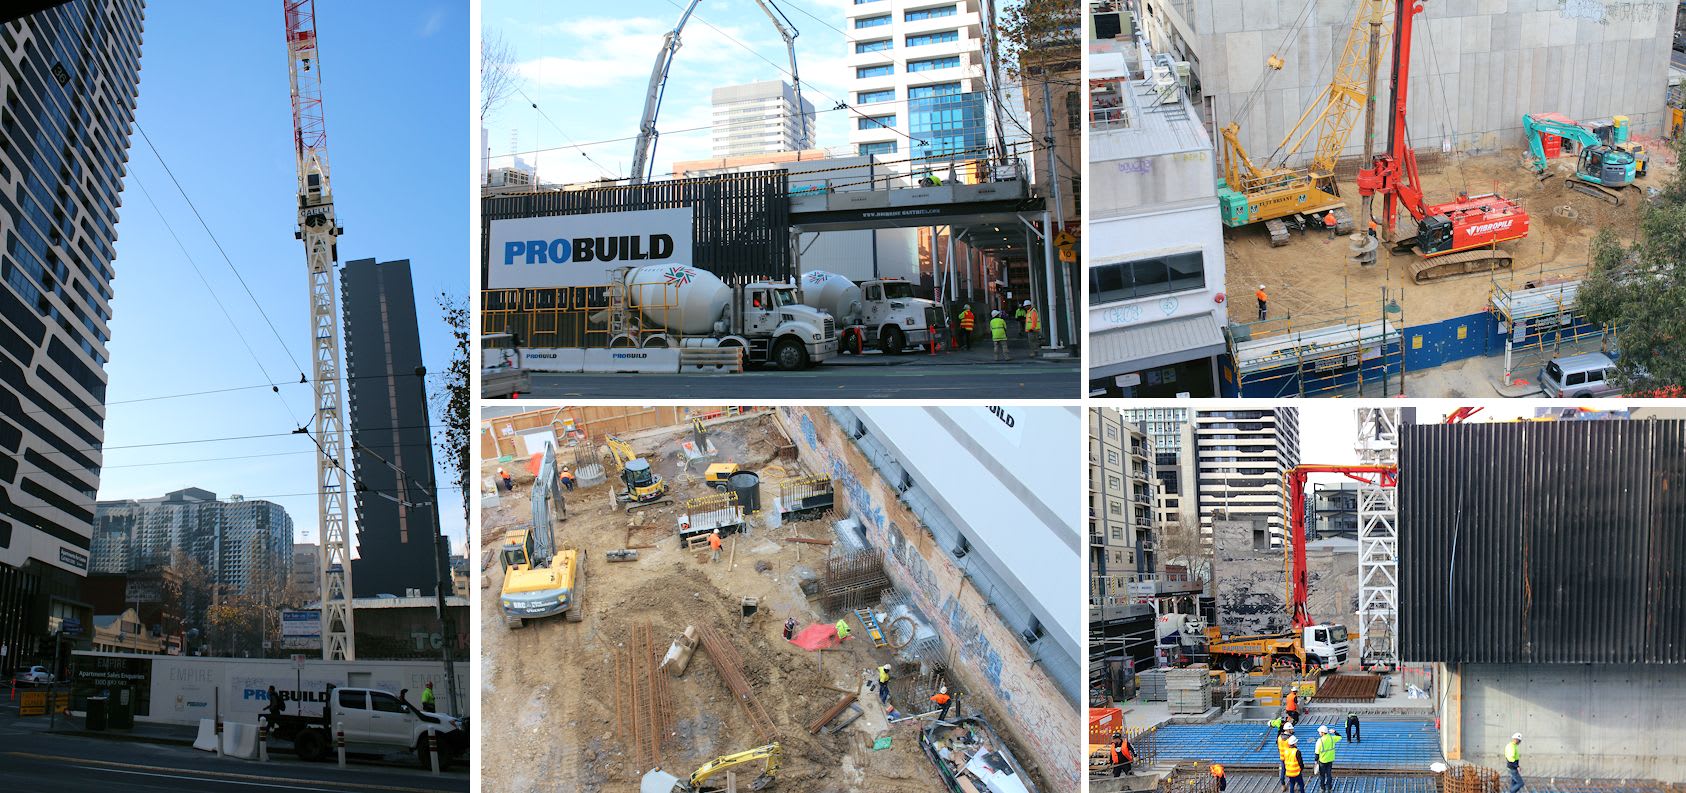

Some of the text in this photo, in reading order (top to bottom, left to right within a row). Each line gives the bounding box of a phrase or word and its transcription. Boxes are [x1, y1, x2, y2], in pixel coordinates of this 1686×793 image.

[53, 65, 67, 84] 36
[1475, 219, 1514, 234] VIBROPILE
[504, 233, 674, 265] PROBUILD
[1063, 249, 1072, 258] 10
[985, 405, 1015, 428] UILD
[97, 657, 128, 669] EMPIRE
[79, 671, 106, 679] Apartment
[107, 671, 120, 679] Sales
[170, 667, 213, 682] EMPIRE
[412, 673, 464, 689] EMPE
